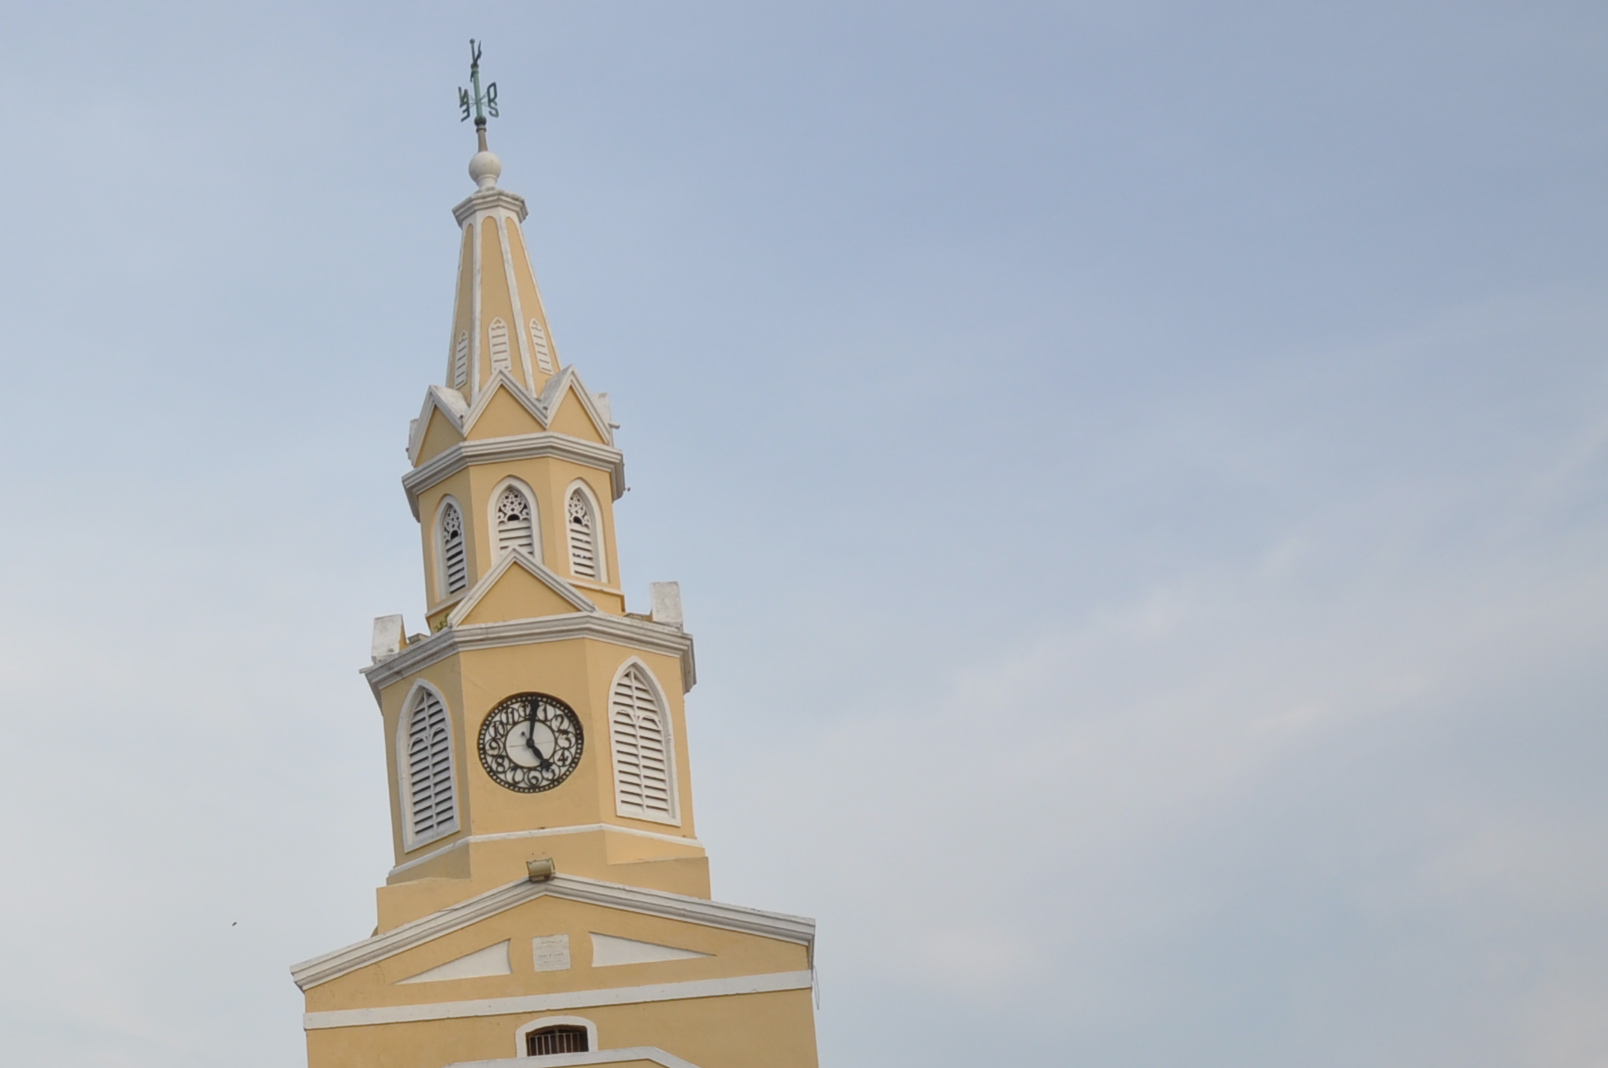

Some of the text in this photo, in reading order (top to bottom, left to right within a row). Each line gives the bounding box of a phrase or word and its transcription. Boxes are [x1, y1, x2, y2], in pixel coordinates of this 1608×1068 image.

[503, 708, 517, 725] 11
[555, 714, 569, 734] 2
[491, 721, 505, 738] 10
[488, 738, 501, 757] 9
[558, 729, 573, 749] 3
[494, 755, 506, 774] 8
[557, 749, 570, 767] 4
[510, 766, 522, 784] 7
